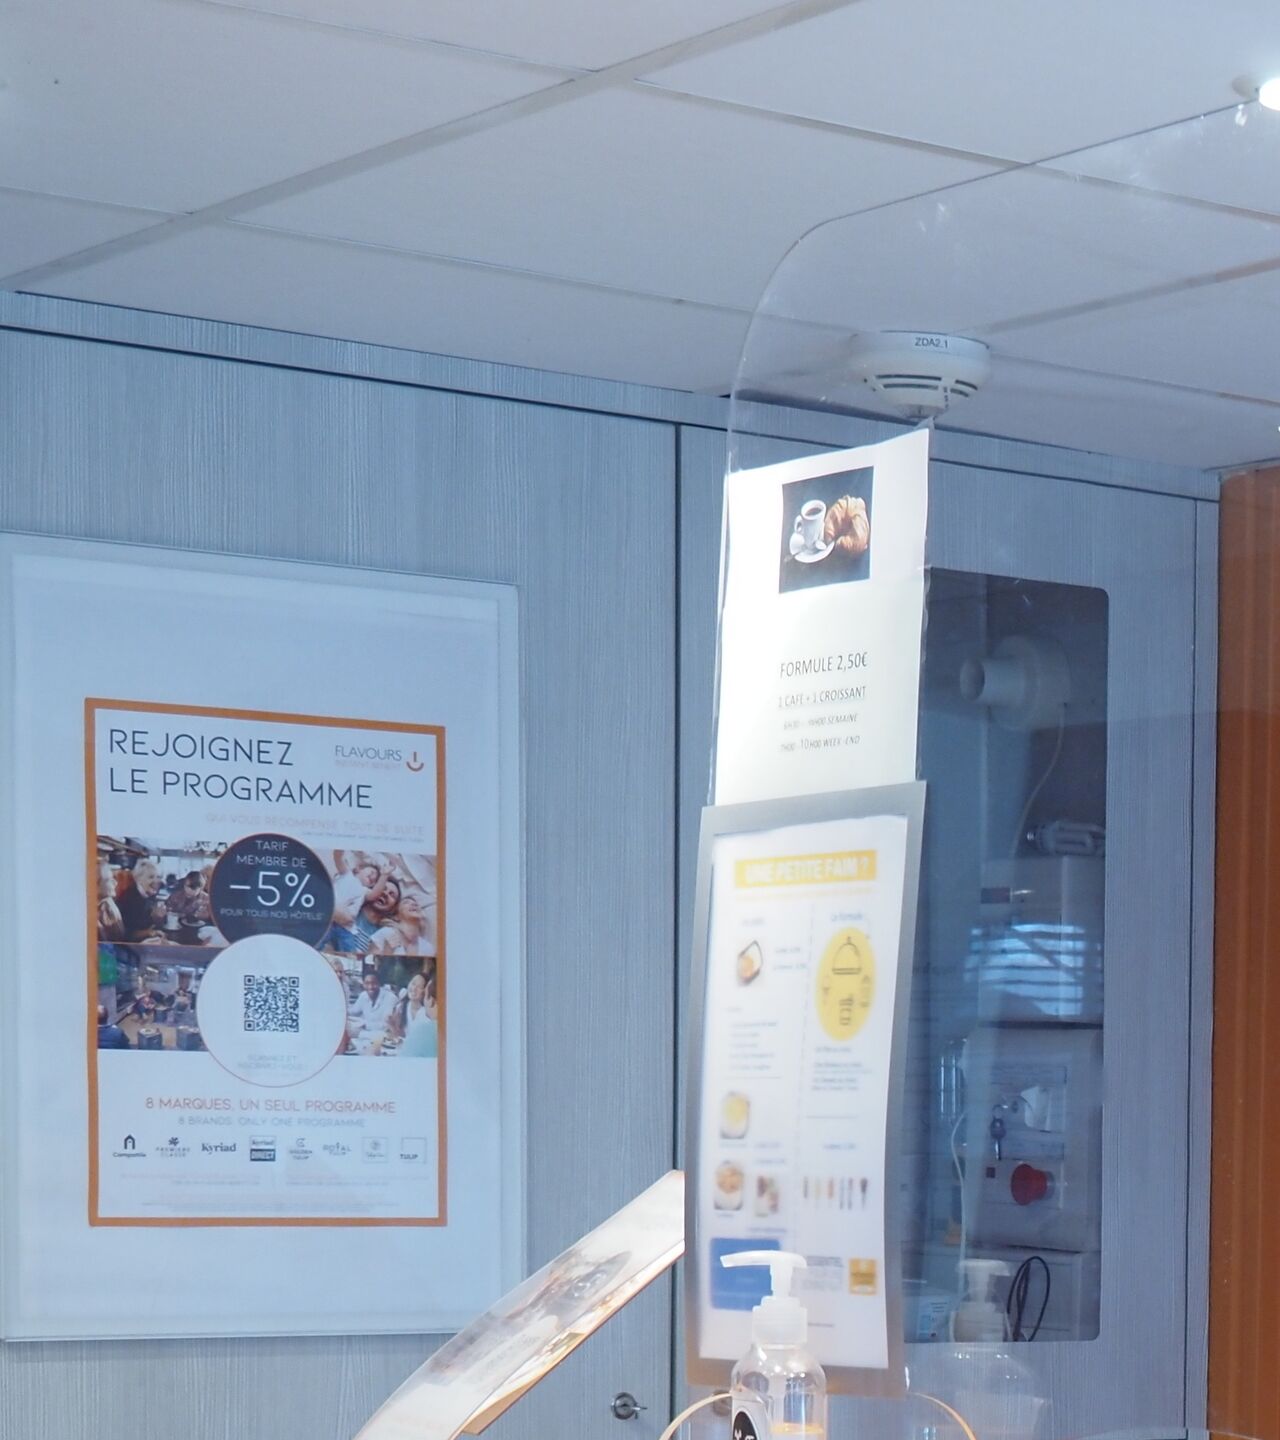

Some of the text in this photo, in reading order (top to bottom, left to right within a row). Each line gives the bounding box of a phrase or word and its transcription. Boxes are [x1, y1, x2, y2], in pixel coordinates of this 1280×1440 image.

[780, 652, 868, 678] FORMULE 2,50€
[819, 686, 866, 703] CROISSANT
[109, 728, 294, 766] REJOIGNEZ
[335, 744, 402, 761] FLAVOURS
[109, 767, 373, 809] LE PROGRAMME
[256, 839, 288, 851] TARIF
[236, 854, 308, 868] MEMBRE DE
[776, 859, 822, 881] PETITE
[826, 856, 858, 878] FAIM
[861, 855, 869, 871] ?
[229, 871, 315, 908] -5%
[145, 1097, 154, 1109] 8
[239, 1098, 260, 1110] UN
[265, 1099, 300, 1112] SEUL
[305, 1100, 396, 1113] PROGRAMME
[239, 1116, 268, 1127] ONLY
[272, 1117, 293, 1127] ONE
[297, 1117, 366, 1128] PROGRAMME
[201, 1142, 237, 1155] Kyriad
